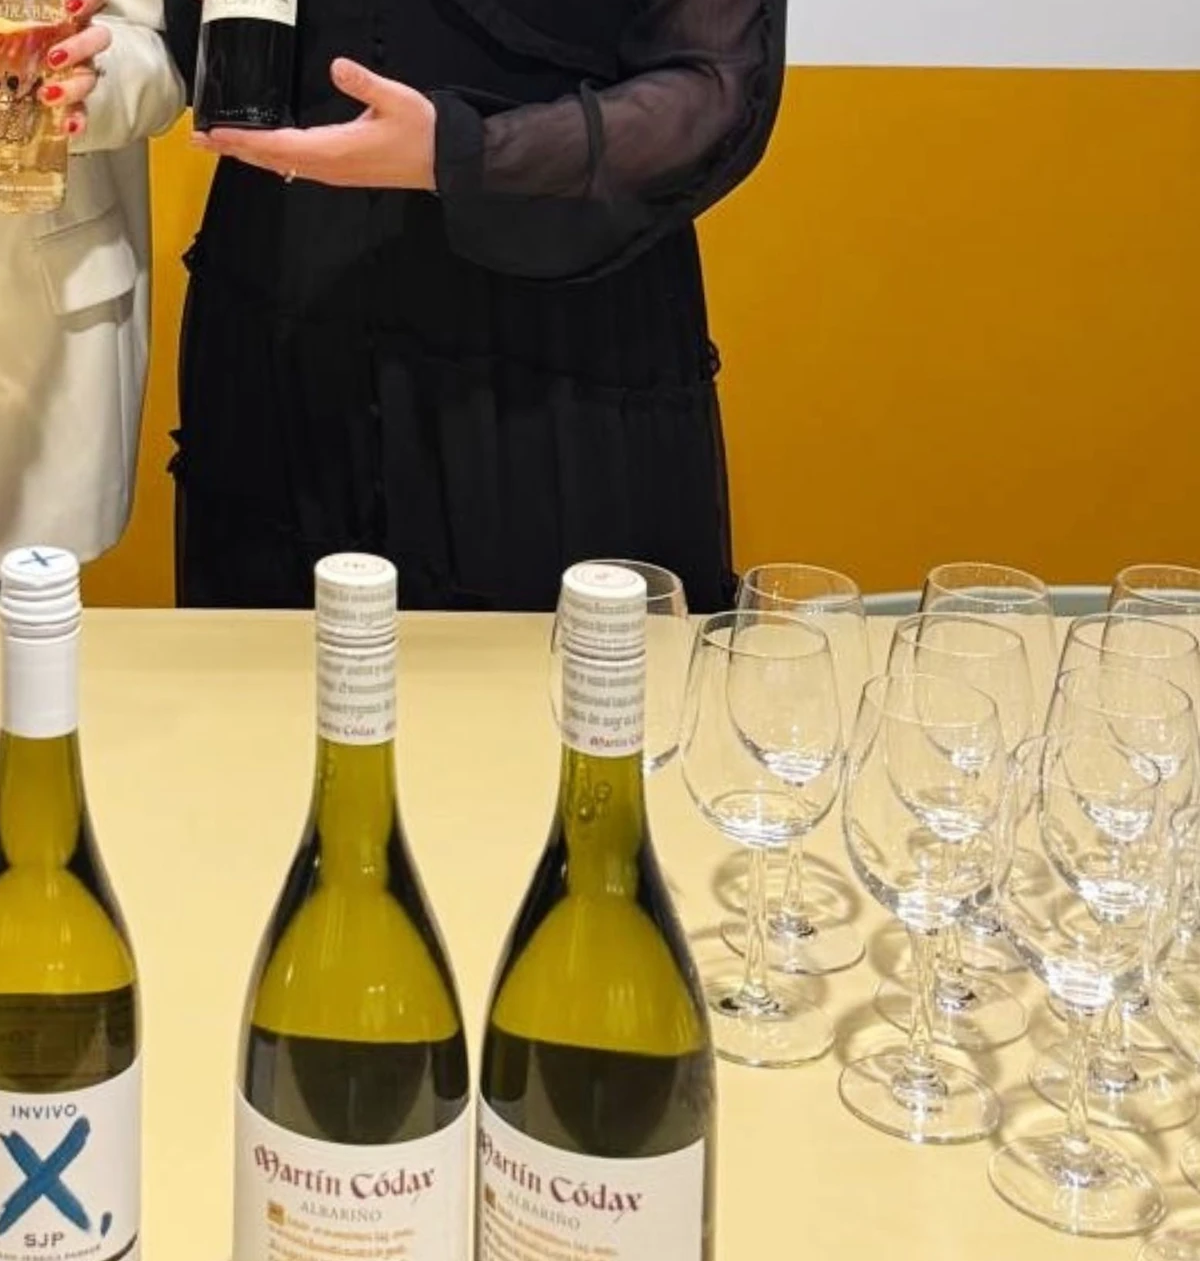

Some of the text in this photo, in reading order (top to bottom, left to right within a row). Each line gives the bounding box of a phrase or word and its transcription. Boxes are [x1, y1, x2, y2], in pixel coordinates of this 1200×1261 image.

[11, 1104, 78, 1120] INVIVO
[254, 1143, 436, 1207] Martín Códax
[550, 1176, 643, 1224] Códax
[23, 1232, 65, 1248] SJP
